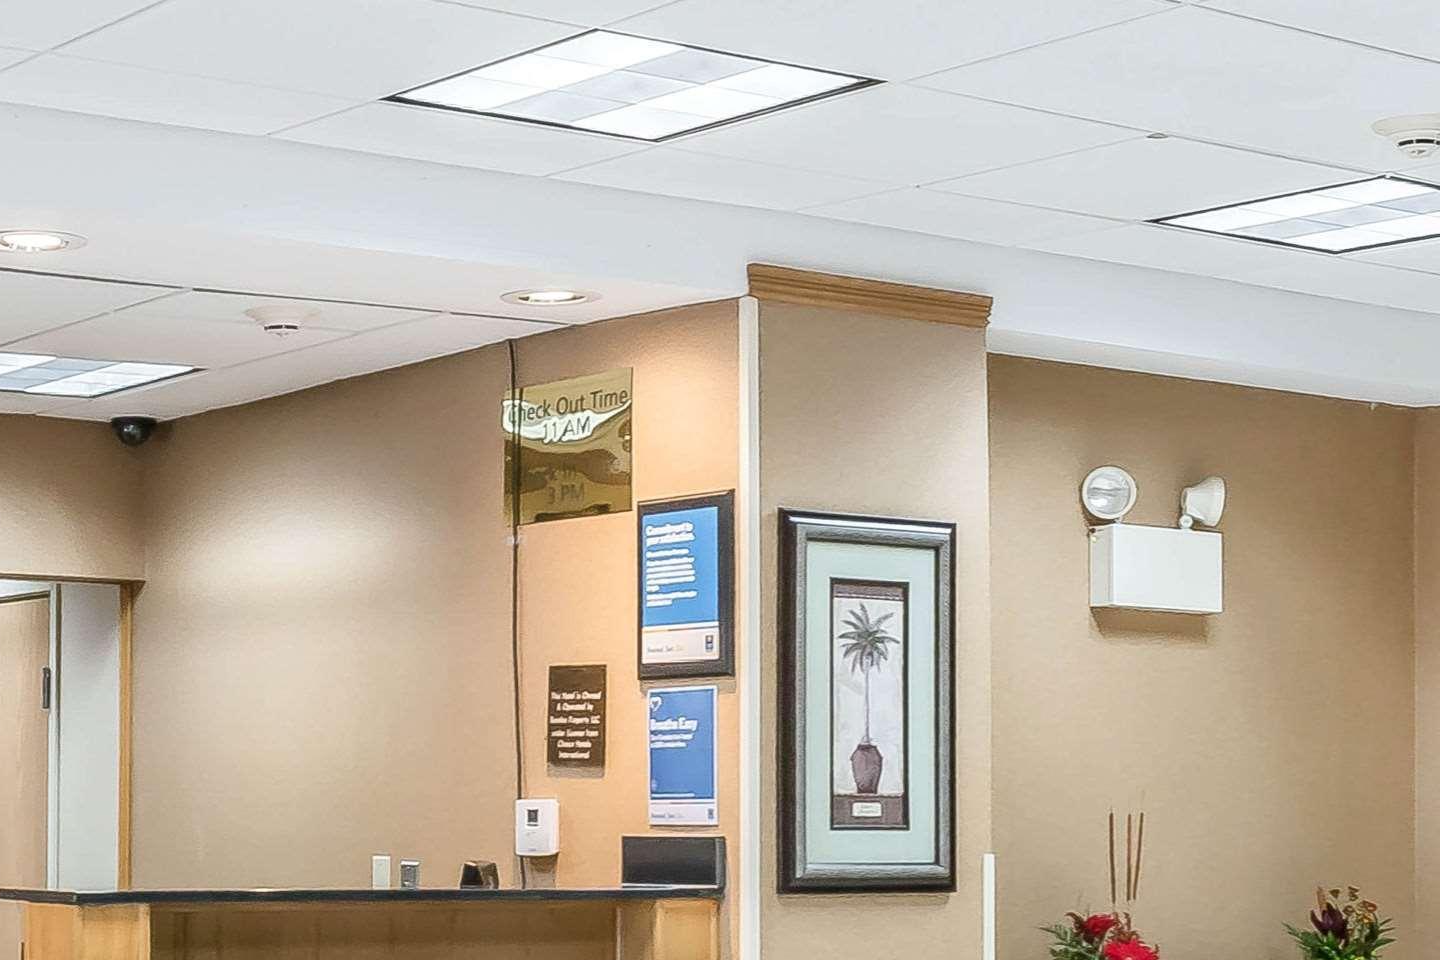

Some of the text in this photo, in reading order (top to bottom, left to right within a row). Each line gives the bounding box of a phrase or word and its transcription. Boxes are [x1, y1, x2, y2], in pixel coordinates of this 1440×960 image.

[508, 389, 628, 423] Check Out Time
[543, 415, 591, 440] 11 AM
[560, 483, 585, 502] PM
